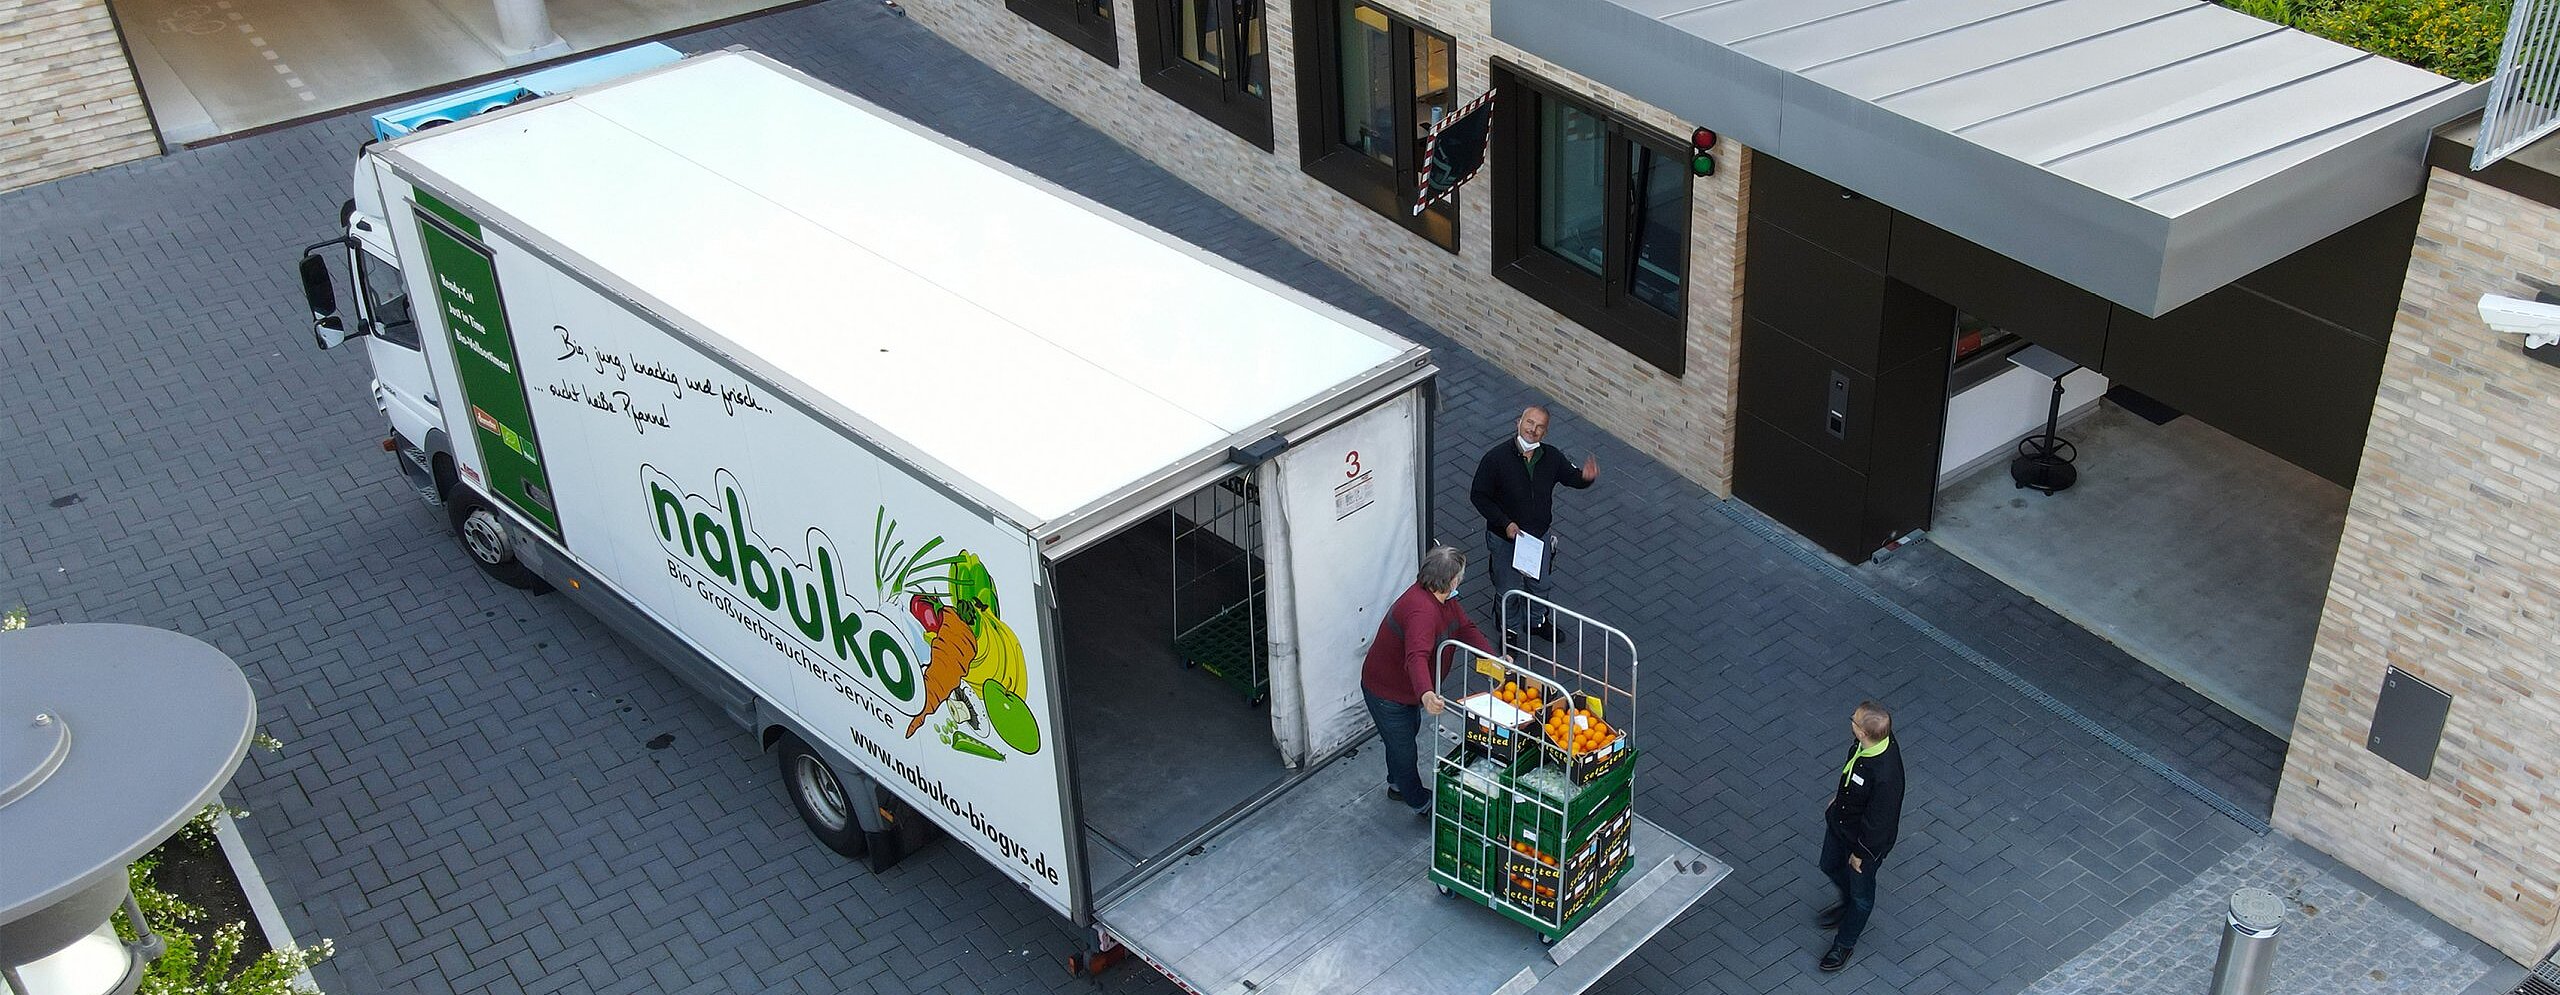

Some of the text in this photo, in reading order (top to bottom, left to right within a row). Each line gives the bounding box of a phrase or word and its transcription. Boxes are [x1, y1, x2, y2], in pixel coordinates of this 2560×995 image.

[549, 378, 580, 403] sucht
[629, 353, 682, 399] knackig
[685, 377, 719, 396] und
[1345, 450, 1361, 479] 3
[650, 481, 915, 702] nabuko
[667, 558, 895, 730] Bio Großverbraucher-Service
[1467, 730, 1510, 747] Seleted
[1582, 748, 1625, 784] Selected
[850, 726, 1059, 886] www.nabuko-biogvs.de
